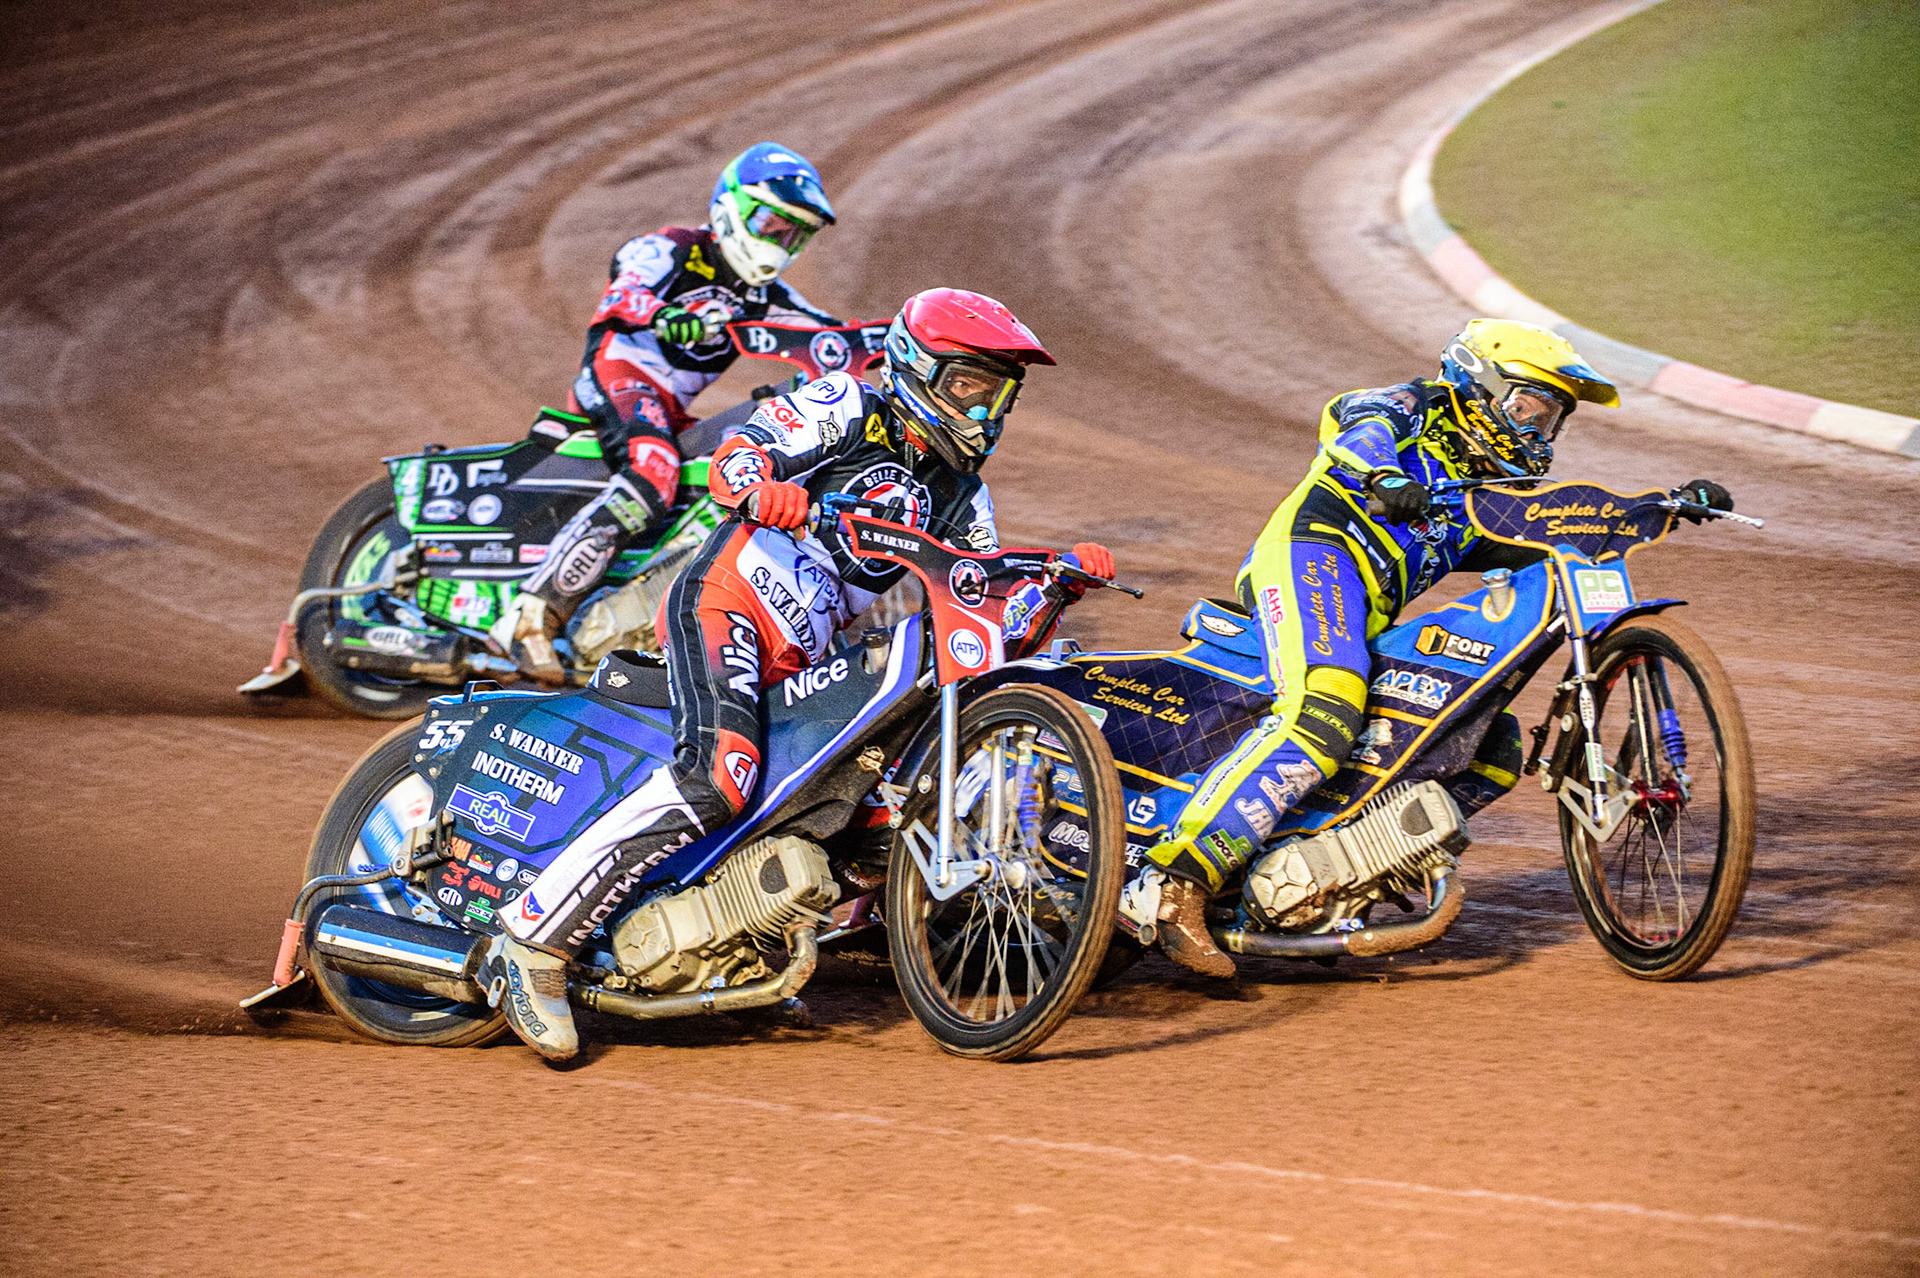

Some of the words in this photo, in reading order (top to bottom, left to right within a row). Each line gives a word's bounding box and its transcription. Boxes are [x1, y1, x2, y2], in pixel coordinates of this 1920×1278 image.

[862, 469, 898, 488] BELLE
[900, 474, 922, 496] VE
[1524, 502, 1598, 522] Complete
[860, 530, 872, 541] S.
[873, 532, 920, 553] WARNER
[1545, 519, 1610, 536] Services
[1301, 560, 1322, 587] Car
[1321, 552, 1340, 580] Ltd
[1580, 572, 1623, 601] PC
[1267, 588, 1284, 625] AHS
[1312, 591, 1334, 656] Complete
[955, 641, 980, 657] ATPI
[1446, 633, 1496, 659] FORT
[783, 657, 849, 708] Nice
[1084, 665, 1152, 696] Complete
[1153, 686, 1186, 706] Car
[1375, 668, 1452, 702] APEX
[1092, 687, 1153, 716] Services
[1154, 707, 1191, 726] Ltd
[419, 719, 474, 750] 55
[489, 723, 506, 743] S.
[508, 728, 584, 775] WARNER
[471, 750, 566, 806] INOTHERM
[1210, 833, 1234, 861] ROCK
[467, 905, 482, 915] ROCK
[508, 959, 549, 1038] daytona
